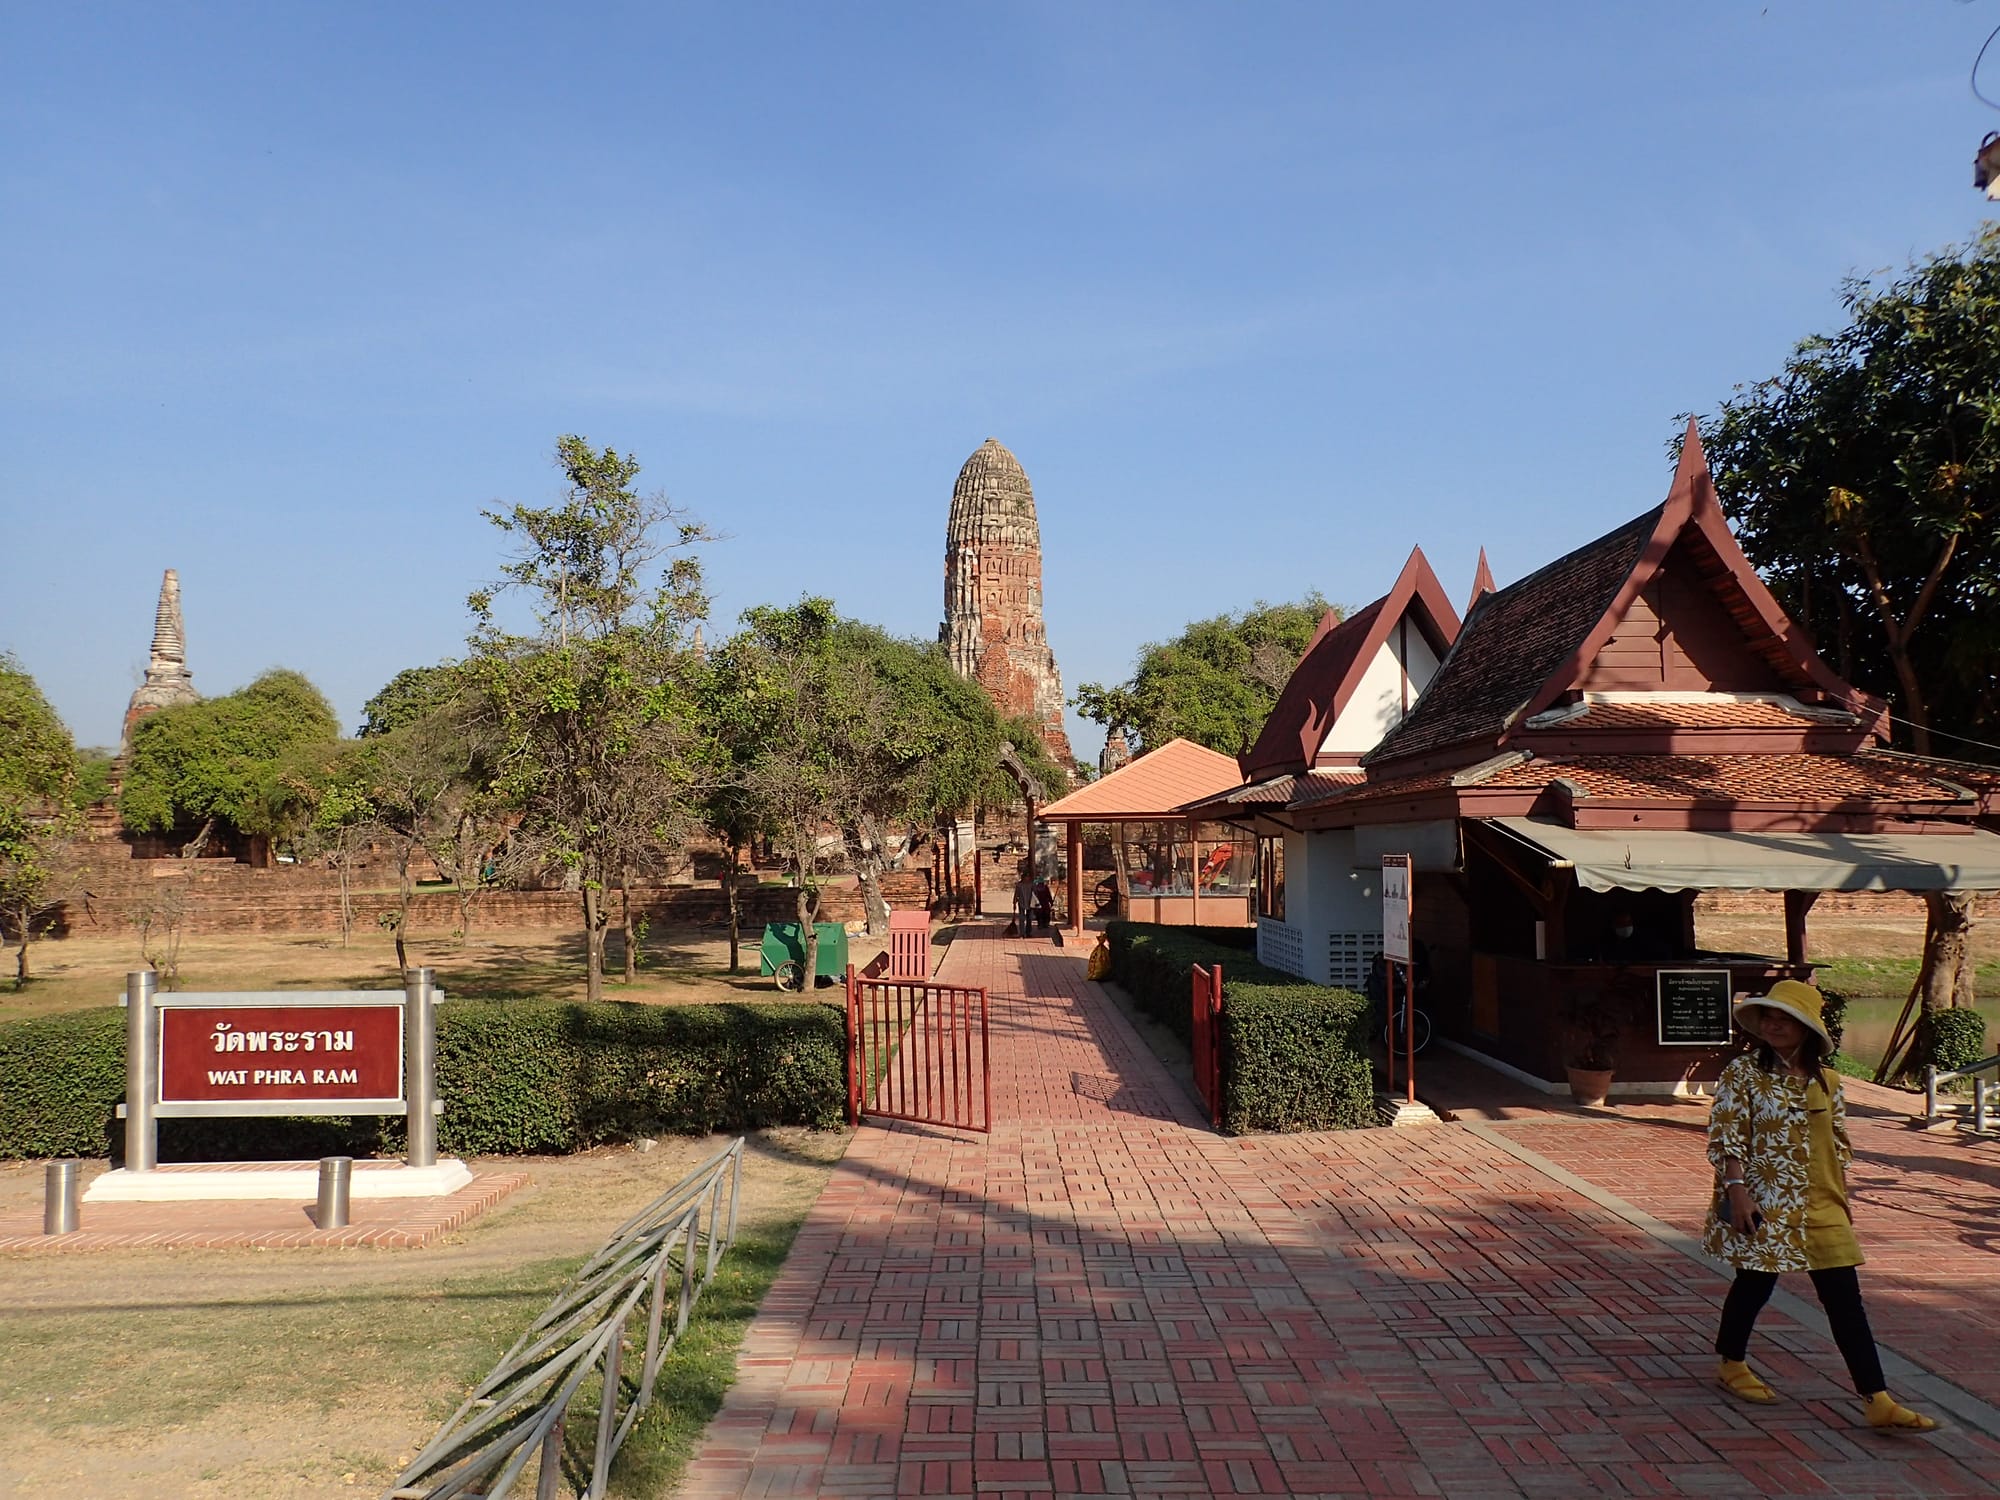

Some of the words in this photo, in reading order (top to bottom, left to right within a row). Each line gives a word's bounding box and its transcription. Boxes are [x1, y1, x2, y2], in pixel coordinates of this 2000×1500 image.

[210, 1022, 353, 1052] วัดพระราม
[207, 1070, 248, 1085] WAT
[253, 1069, 306, 1085] PHRA
[312, 1069, 358, 1084] RAM
